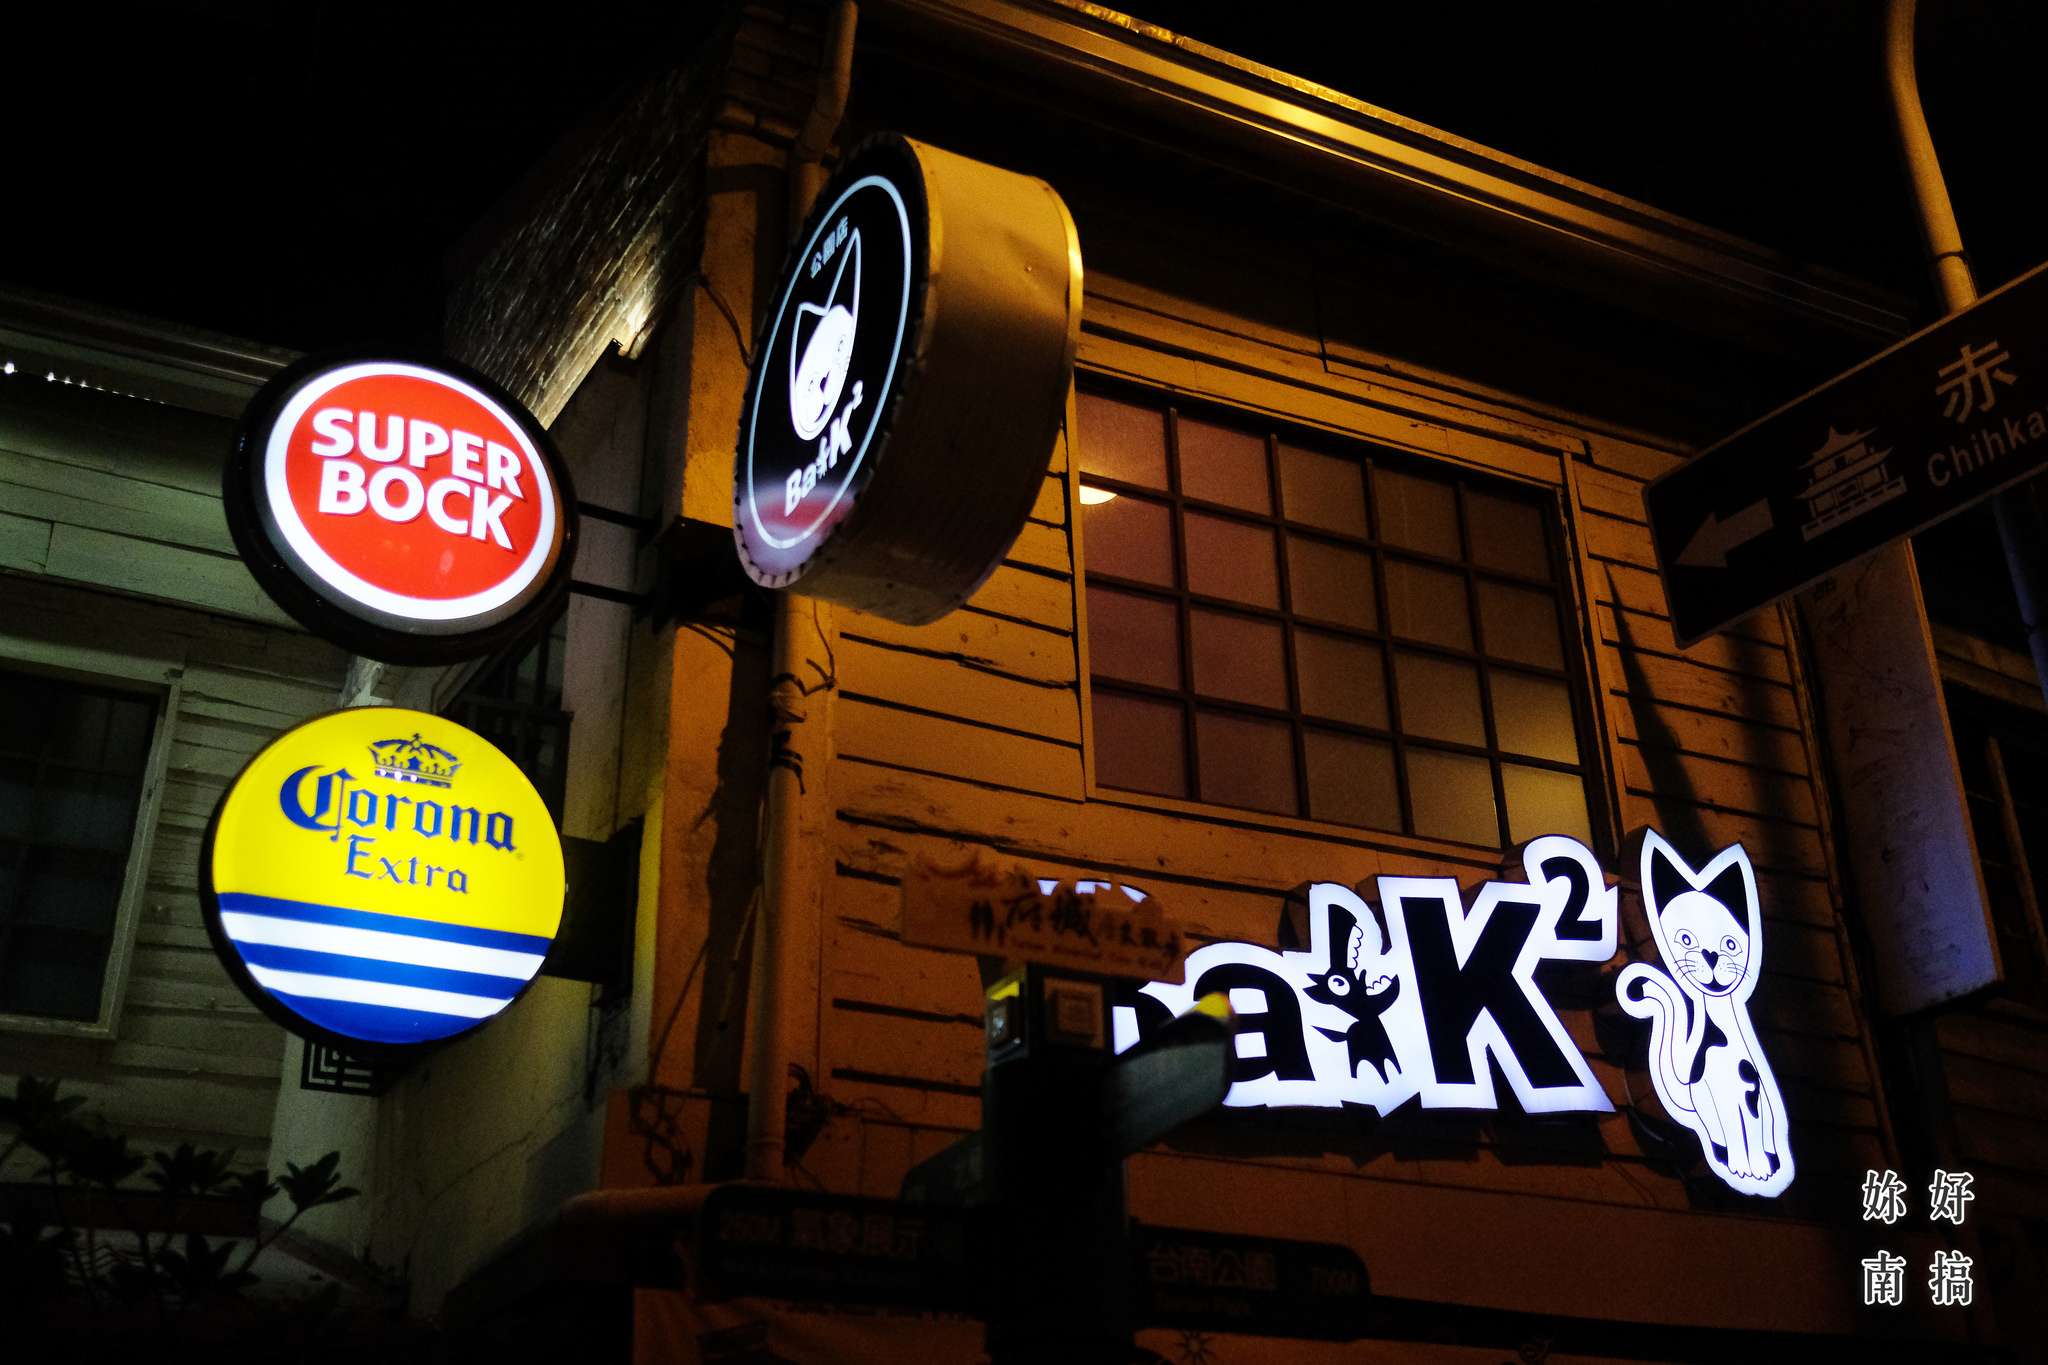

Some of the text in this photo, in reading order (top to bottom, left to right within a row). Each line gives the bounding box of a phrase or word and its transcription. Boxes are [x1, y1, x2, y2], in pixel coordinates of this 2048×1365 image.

[1934, 340, 2018, 424] 赤
[311, 406, 526, 501] SUPER
[1927, 403, 2048, 487] Chihka
[318, 458, 516, 552] BOCK
[279, 764, 518, 853] Corona
[345, 833, 469, 895] Extra
